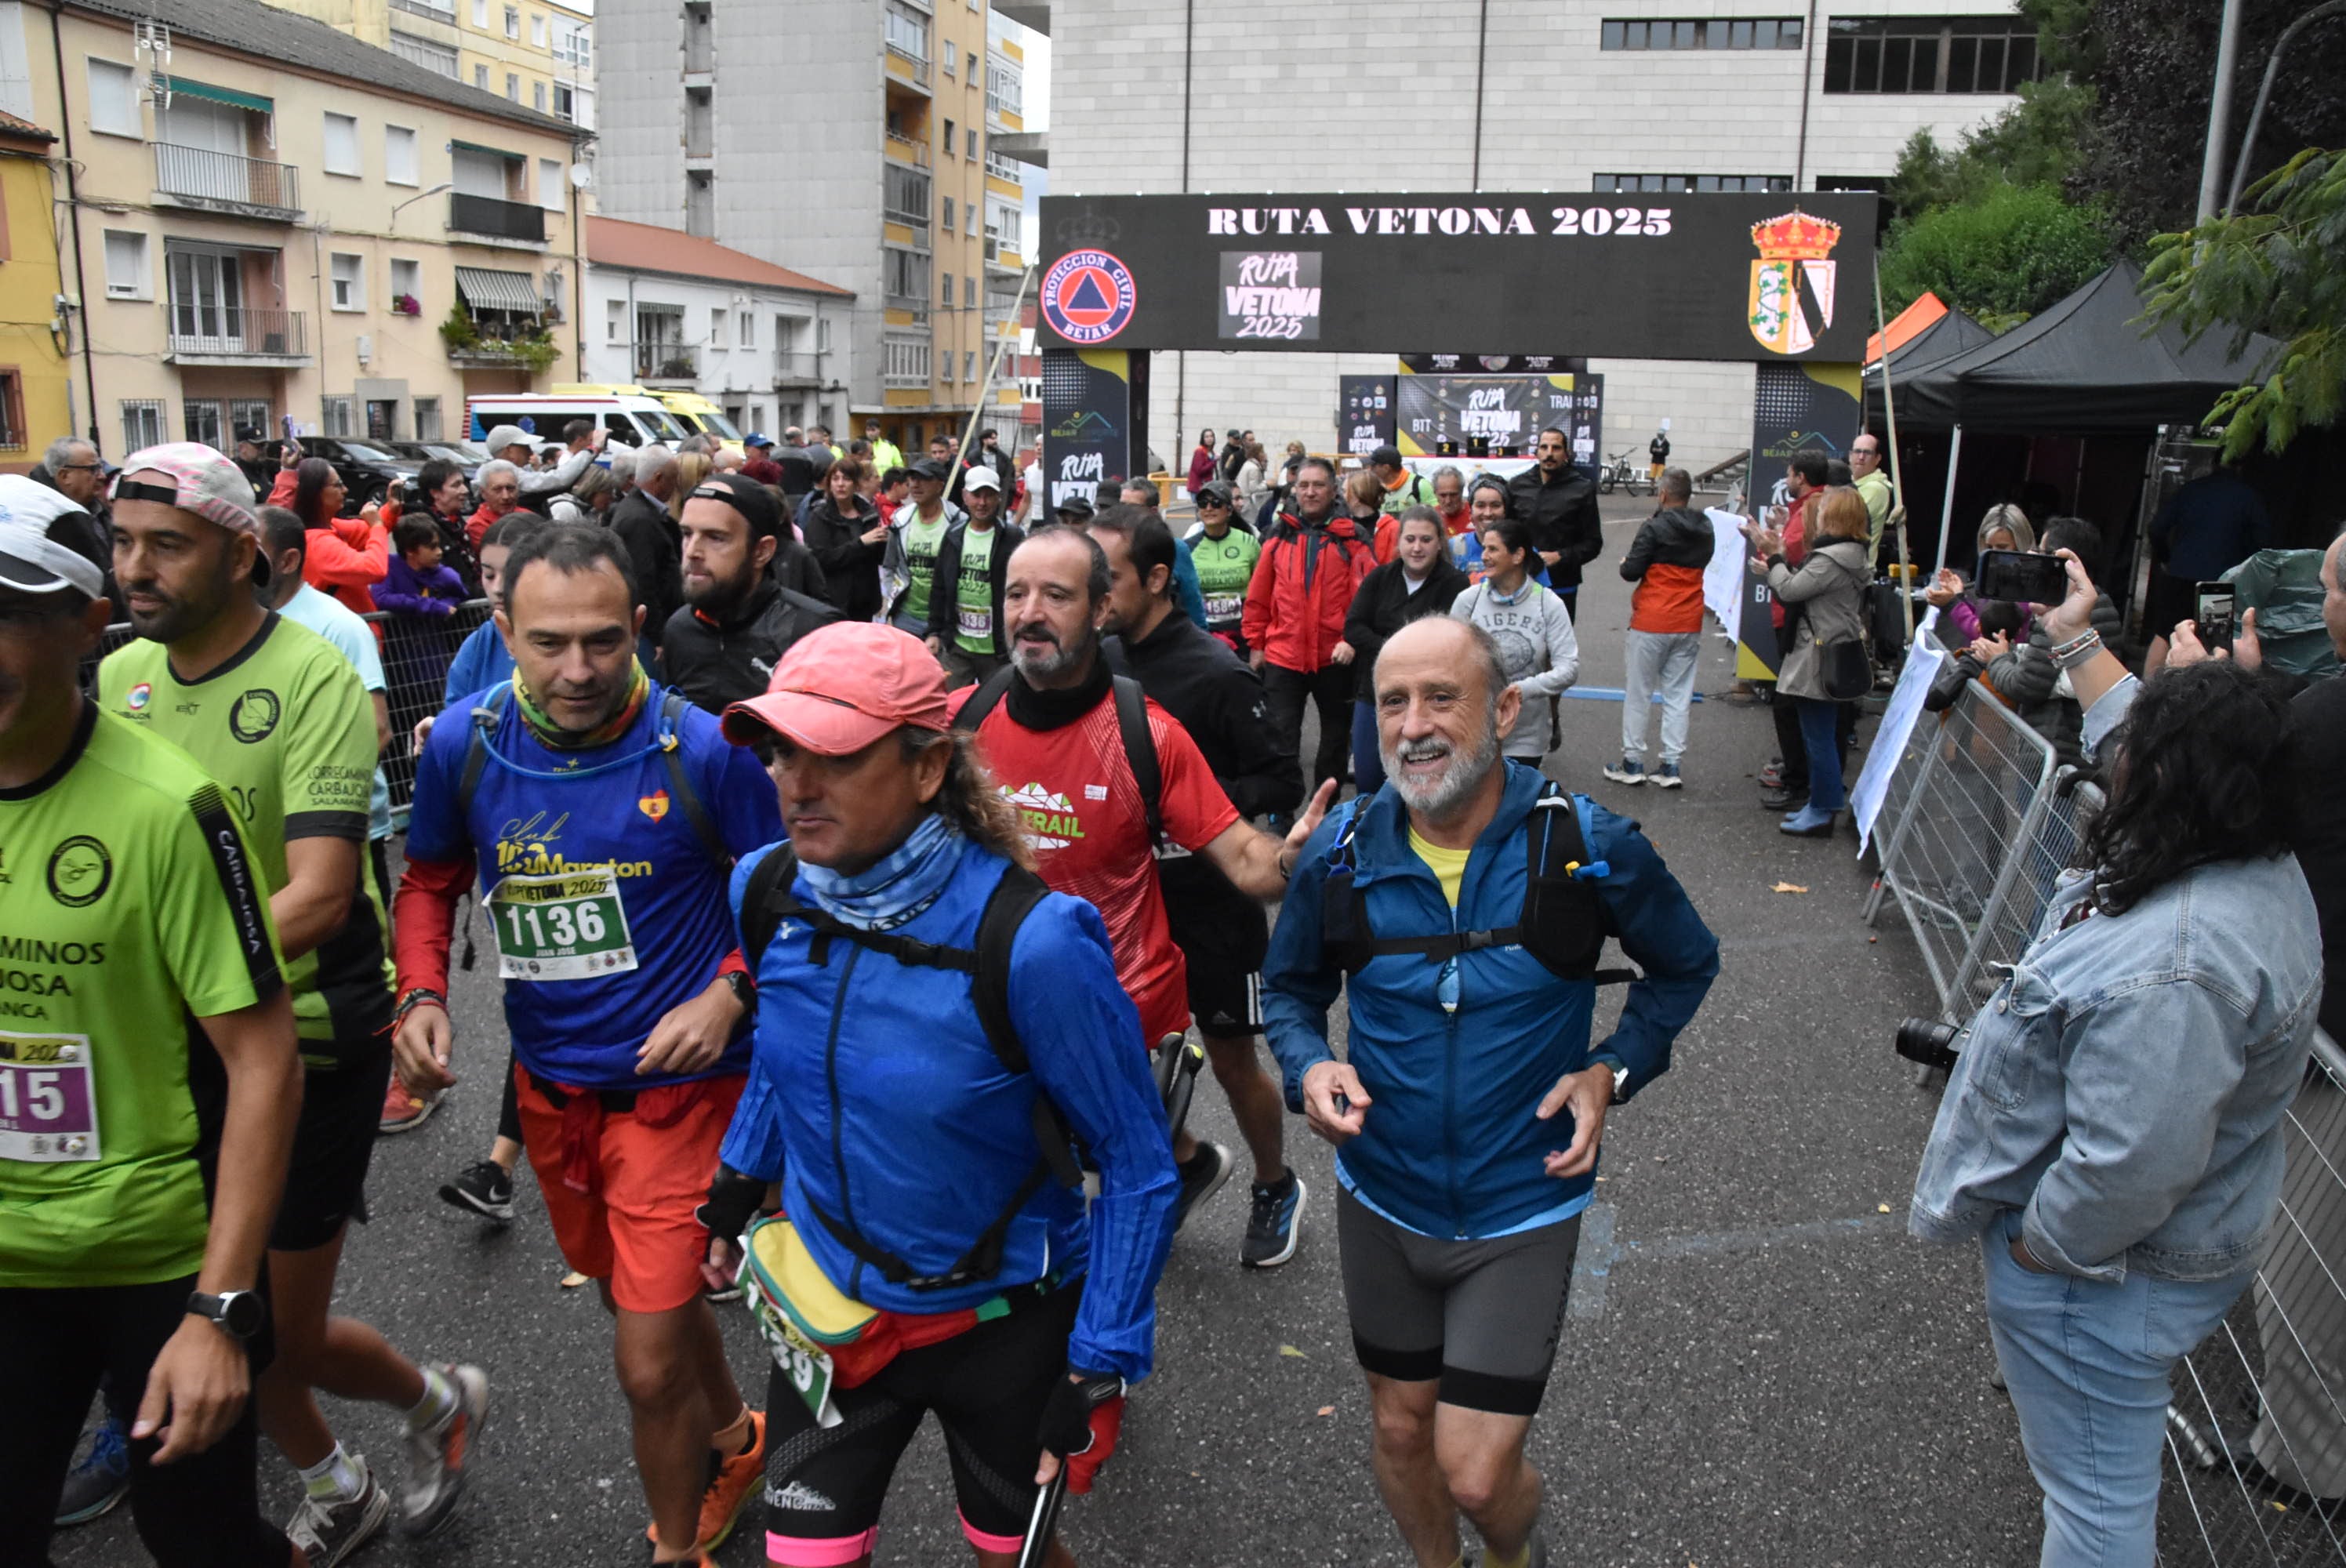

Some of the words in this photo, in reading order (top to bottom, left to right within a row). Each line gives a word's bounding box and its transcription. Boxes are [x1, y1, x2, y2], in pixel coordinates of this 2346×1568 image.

[1208, 208, 1333, 235] RUTA
[1345, 207, 1538, 235] VETONA
[1551, 207, 1672, 236] 2025
[1045, 254, 1107, 307] PROTECCION
[1113, 268, 1132, 310] CIVIL
[1238, 252, 1298, 288] RUTA
[1226, 286, 1322, 317] VETONA
[1063, 323, 1112, 340] BEJAR
[1236, 316, 1303, 339] 2025
[1469, 387, 1505, 412] RUTA
[1549, 395, 1573, 408] TRAI
[1412, 419, 1432, 432] BTT
[1460, 410, 1521, 432] VETONA
[1061, 452, 1103, 482] RUTA
[506, 901, 606, 947] 1136
